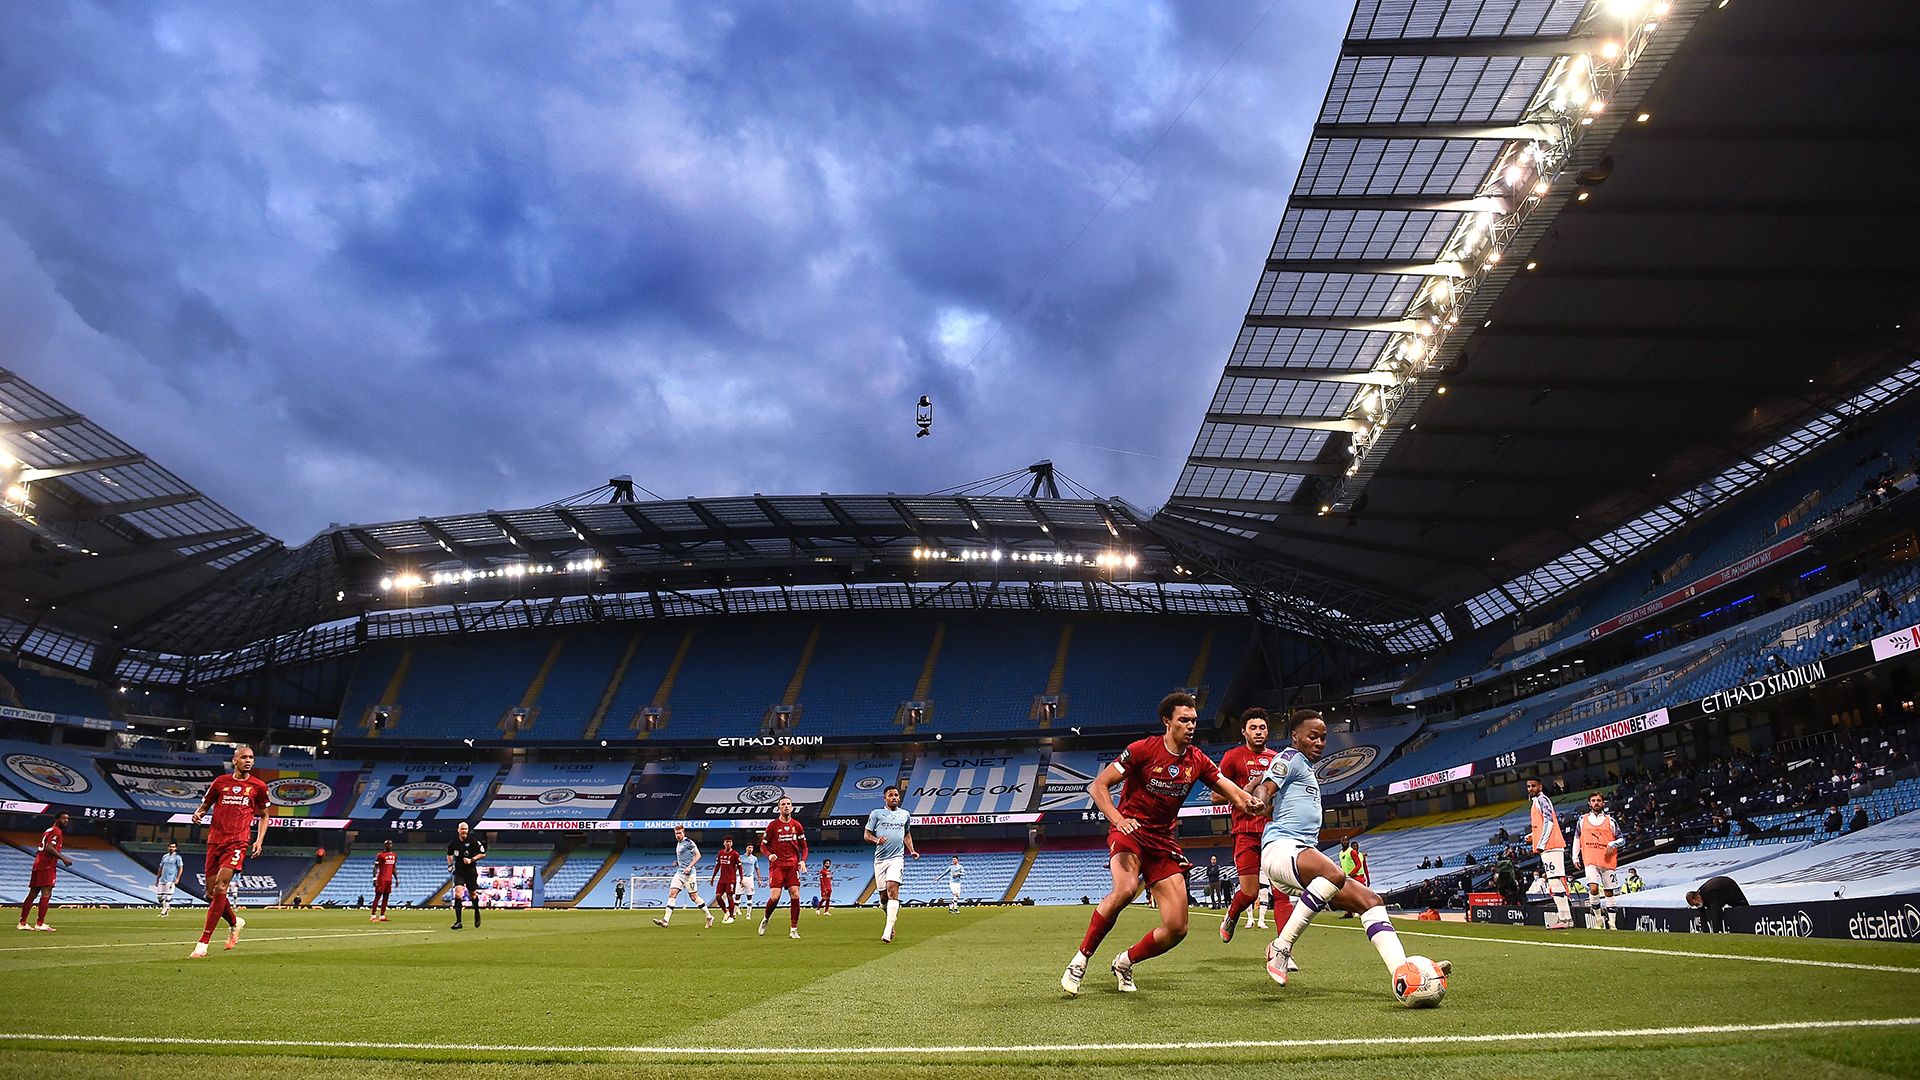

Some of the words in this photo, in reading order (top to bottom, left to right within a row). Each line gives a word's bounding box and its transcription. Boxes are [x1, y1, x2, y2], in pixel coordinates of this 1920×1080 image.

[1701, 680, 1766, 714] ETIHAD
[1768, 660, 1826, 695] STADIUM
[3, 708, 21, 718] CITY
[1583, 715, 1647, 745] MARATHONBET
[717, 736, 775, 747] ETIHAD
[778, 735, 823, 746] STADIUM
[738, 764, 790, 772] etisalat
[942, 757, 1013, 768] QNET
[116, 763, 214, 778] MANCHESTER
[404, 764, 471, 773] UBTECH
[748, 775, 788, 783] MCFC
[1149, 778, 1184, 789] Standard
[1409, 771, 1450, 789] MARATHONBET
[912, 787, 986, 797] MCFC
[988, 783, 1028, 795] OK
[1047, 785, 1064, 793] MCR
[1064, 784, 1084, 792] BORN
[704, 806, 727, 815] GO
[728, 806, 756, 814] LET
[756, 806, 771, 814] IT
[772, 806, 804, 814] OT
[521, 821, 598, 829] MARATHONBET
[644, 821, 692, 829] MANCHESTER
[693, 820, 710, 829] CITY
[822, 818, 860, 827] LIVERPOOL
[921, 815, 998, 824] MARATHONBET
[232, 849, 242, 862] 3
[1544, 861, 1556, 872] 26
[1754, 915, 1799, 938] etisalat
[1849, 910, 1908, 940] etisalat
